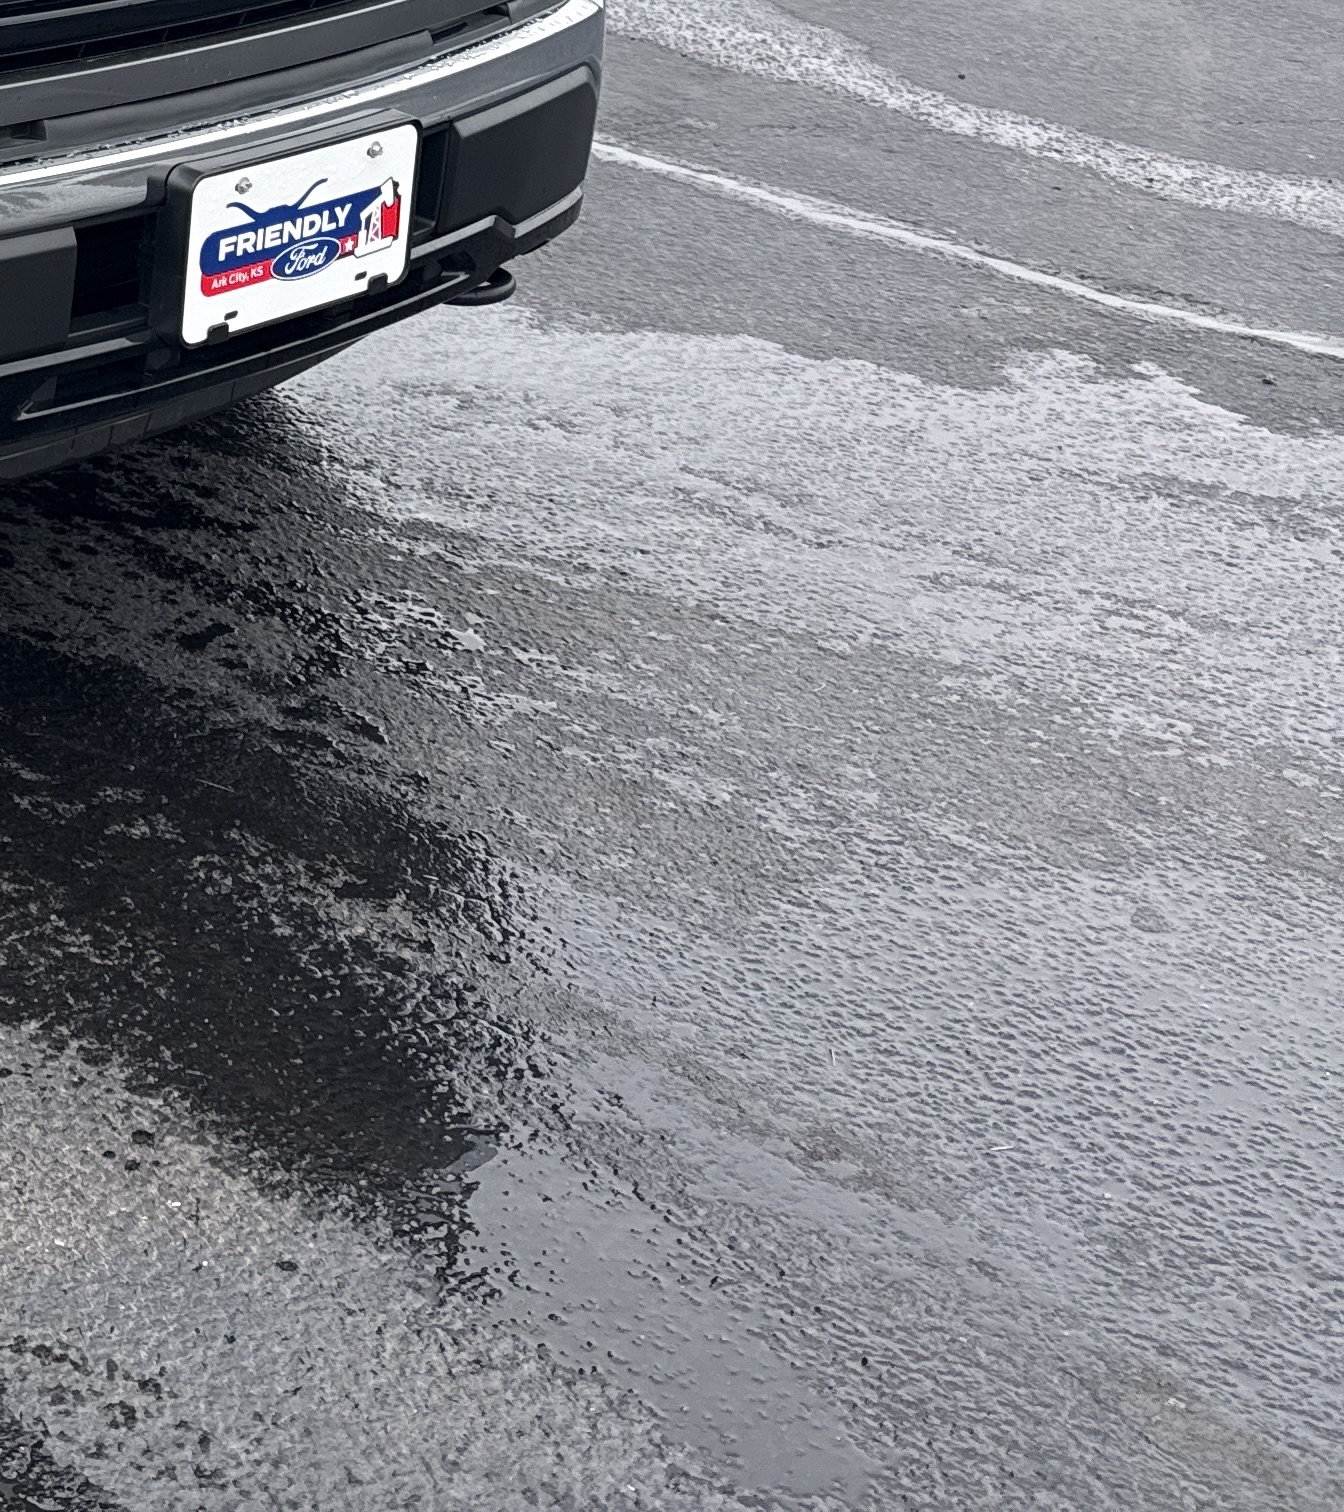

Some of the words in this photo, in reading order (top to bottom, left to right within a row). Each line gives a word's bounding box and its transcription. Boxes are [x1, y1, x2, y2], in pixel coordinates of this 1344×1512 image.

[218, 202, 353, 262] FRIENDLY
[284, 243, 328, 275] Ford
[211, 275, 227, 289] Ark
[228, 271, 249, 285] City,
[250, 266, 264, 279] KS
